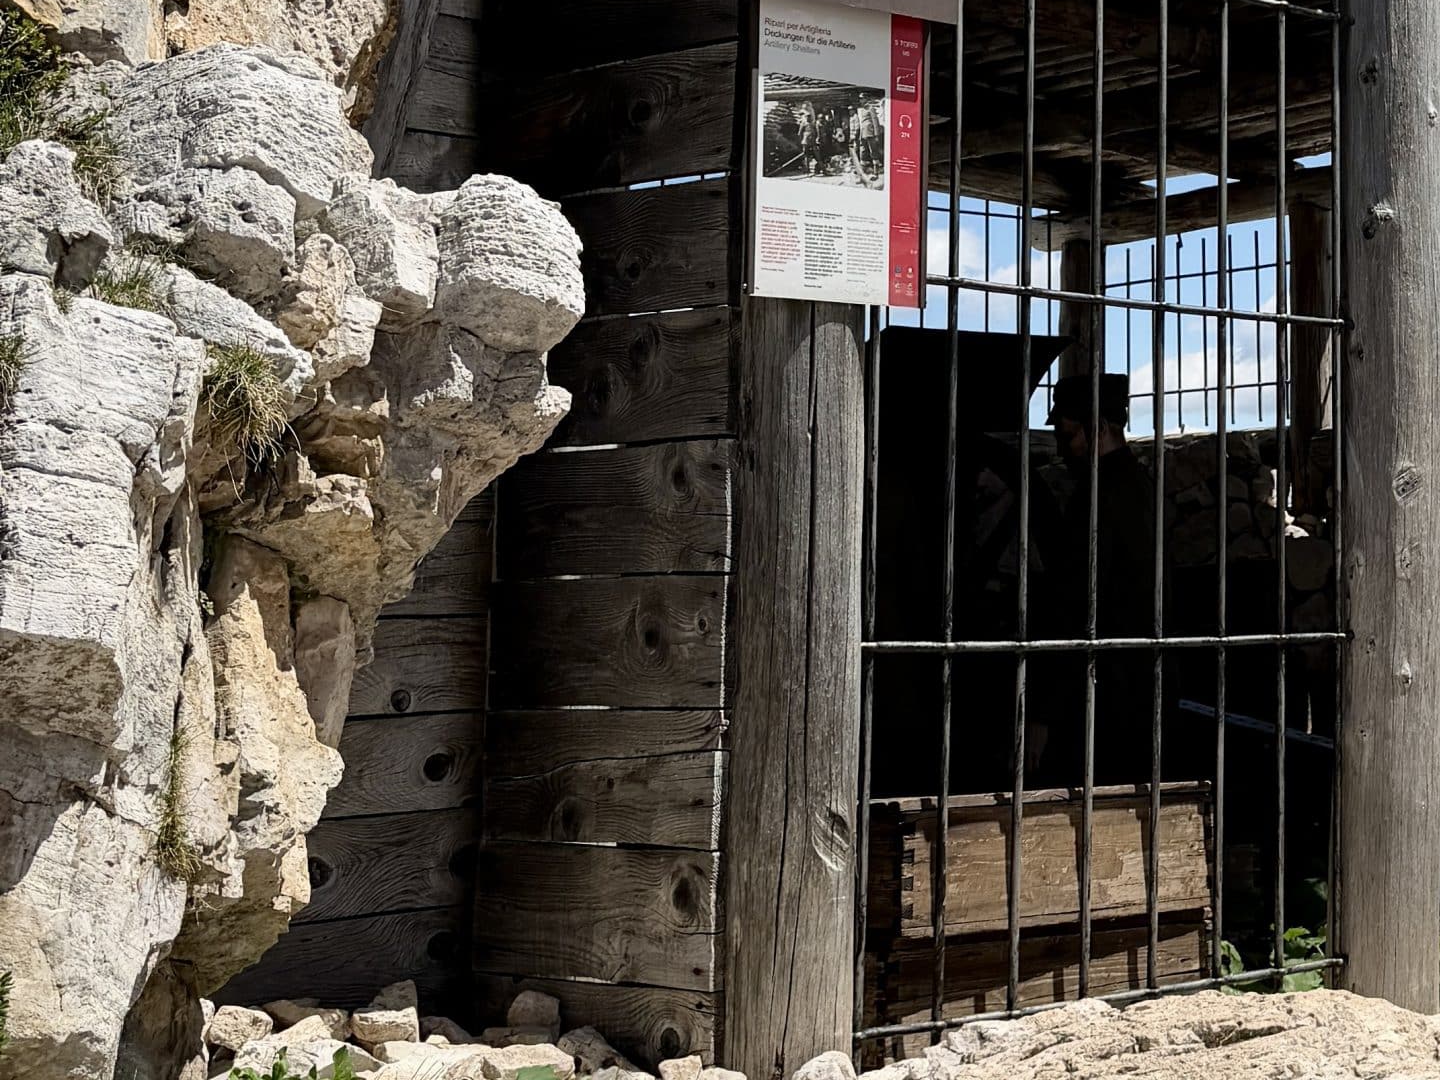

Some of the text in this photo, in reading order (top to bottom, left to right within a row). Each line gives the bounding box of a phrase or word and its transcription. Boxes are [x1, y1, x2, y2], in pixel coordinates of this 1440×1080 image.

[787, 23, 798, 32] per
[806, 35, 815, 44] für
[817, 38, 827, 46] die
